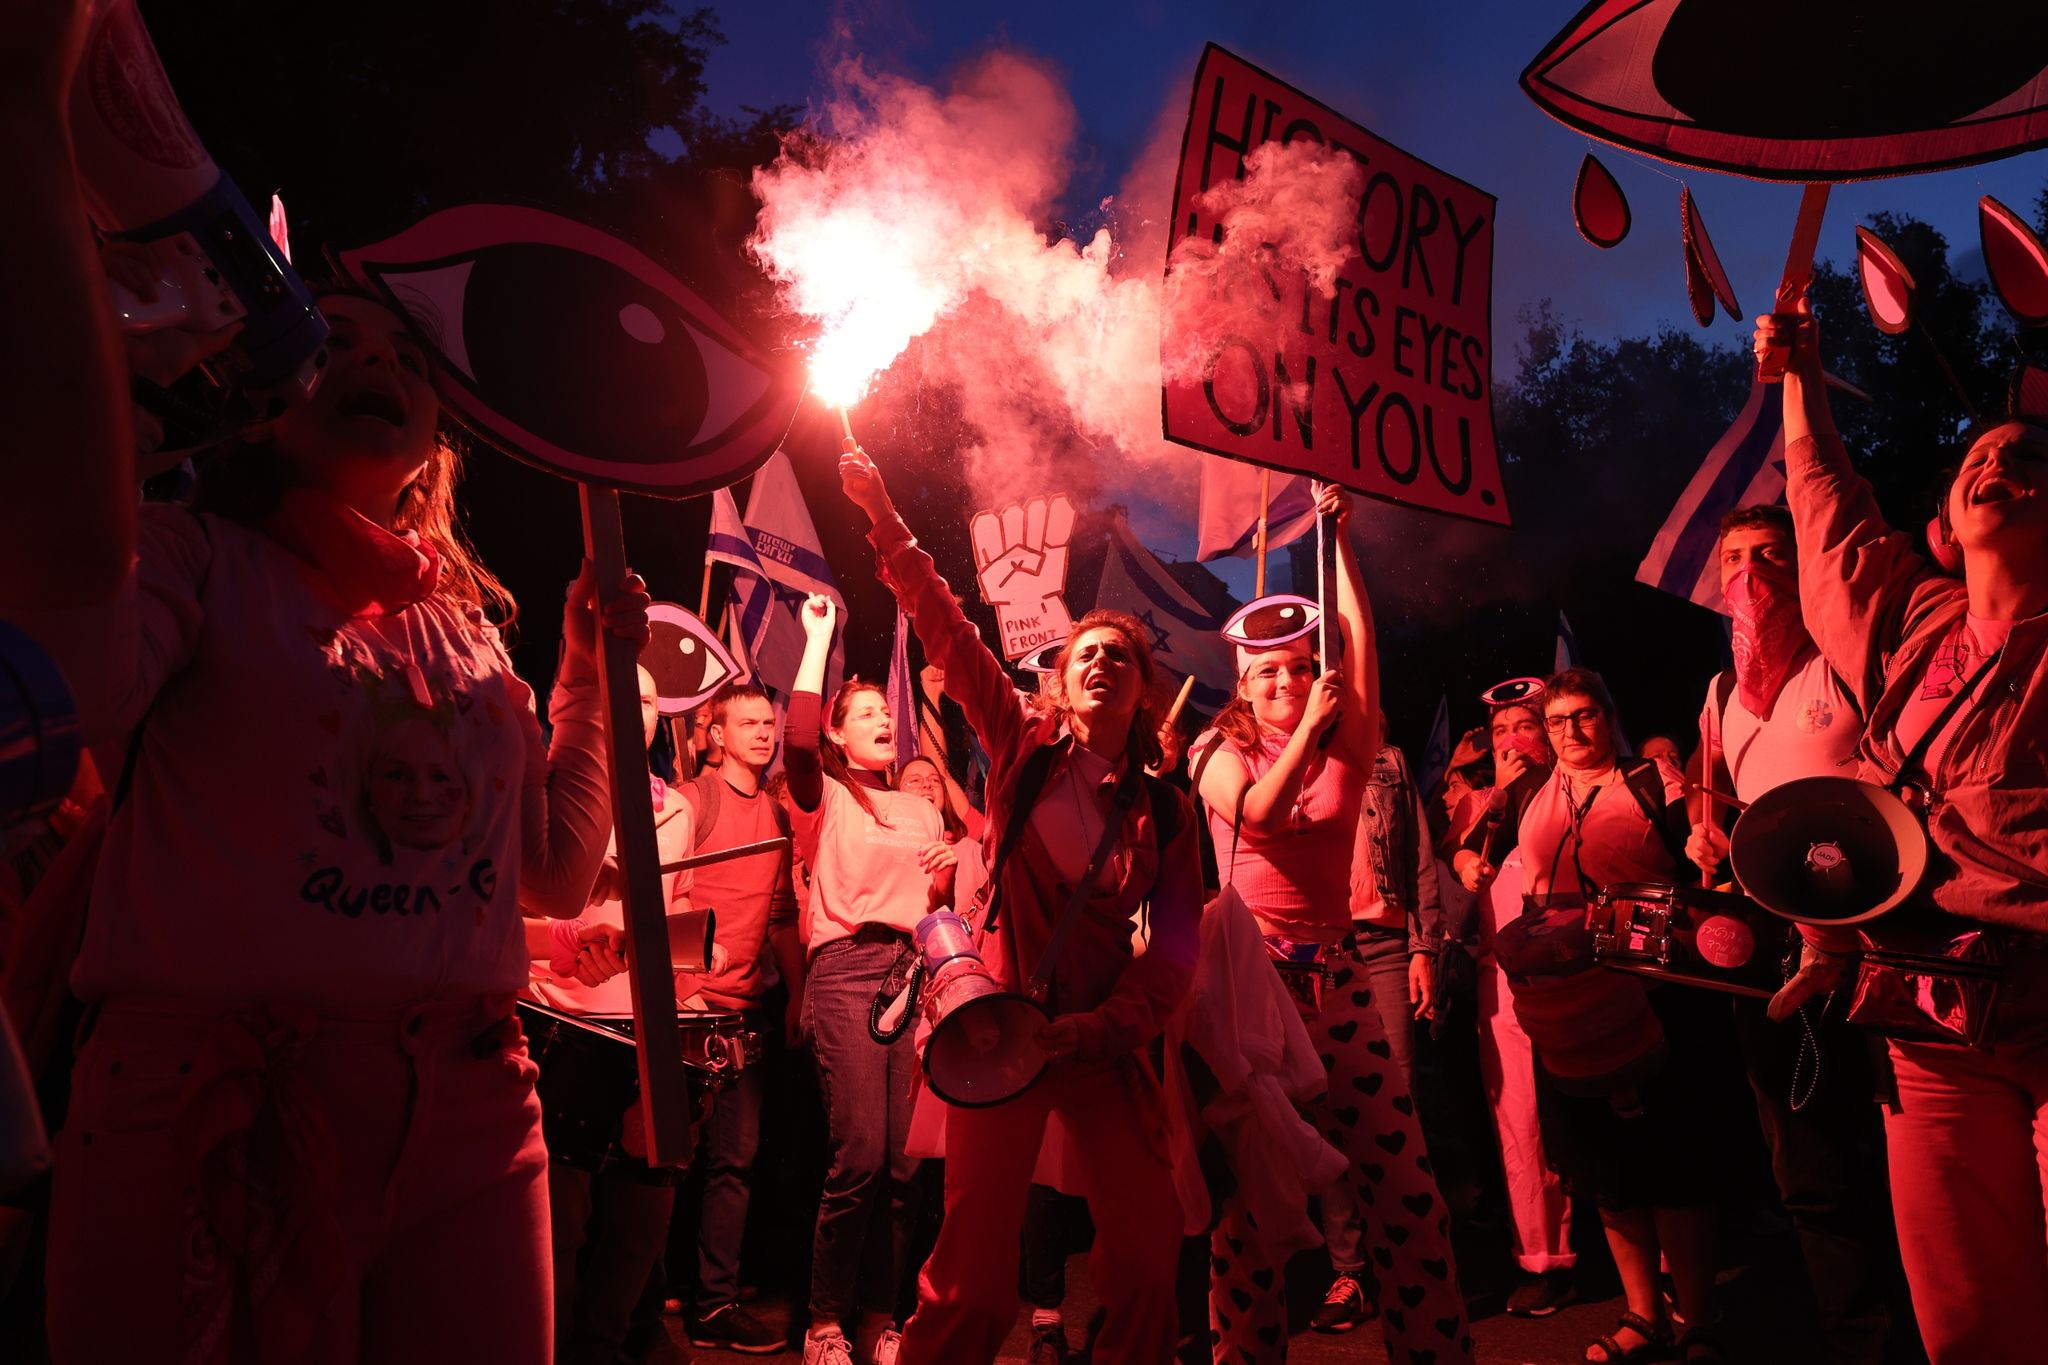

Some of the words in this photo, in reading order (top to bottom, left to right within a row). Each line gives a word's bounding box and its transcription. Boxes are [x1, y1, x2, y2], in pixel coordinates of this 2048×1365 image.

[1393, 304, 1484, 400] EYES
[1203, 335, 1316, 450] ON
[1332, 366, 1496, 507] YOU.
[1005, 616, 1041, 633] PINK
[1009, 629, 1057, 652] FRONT
